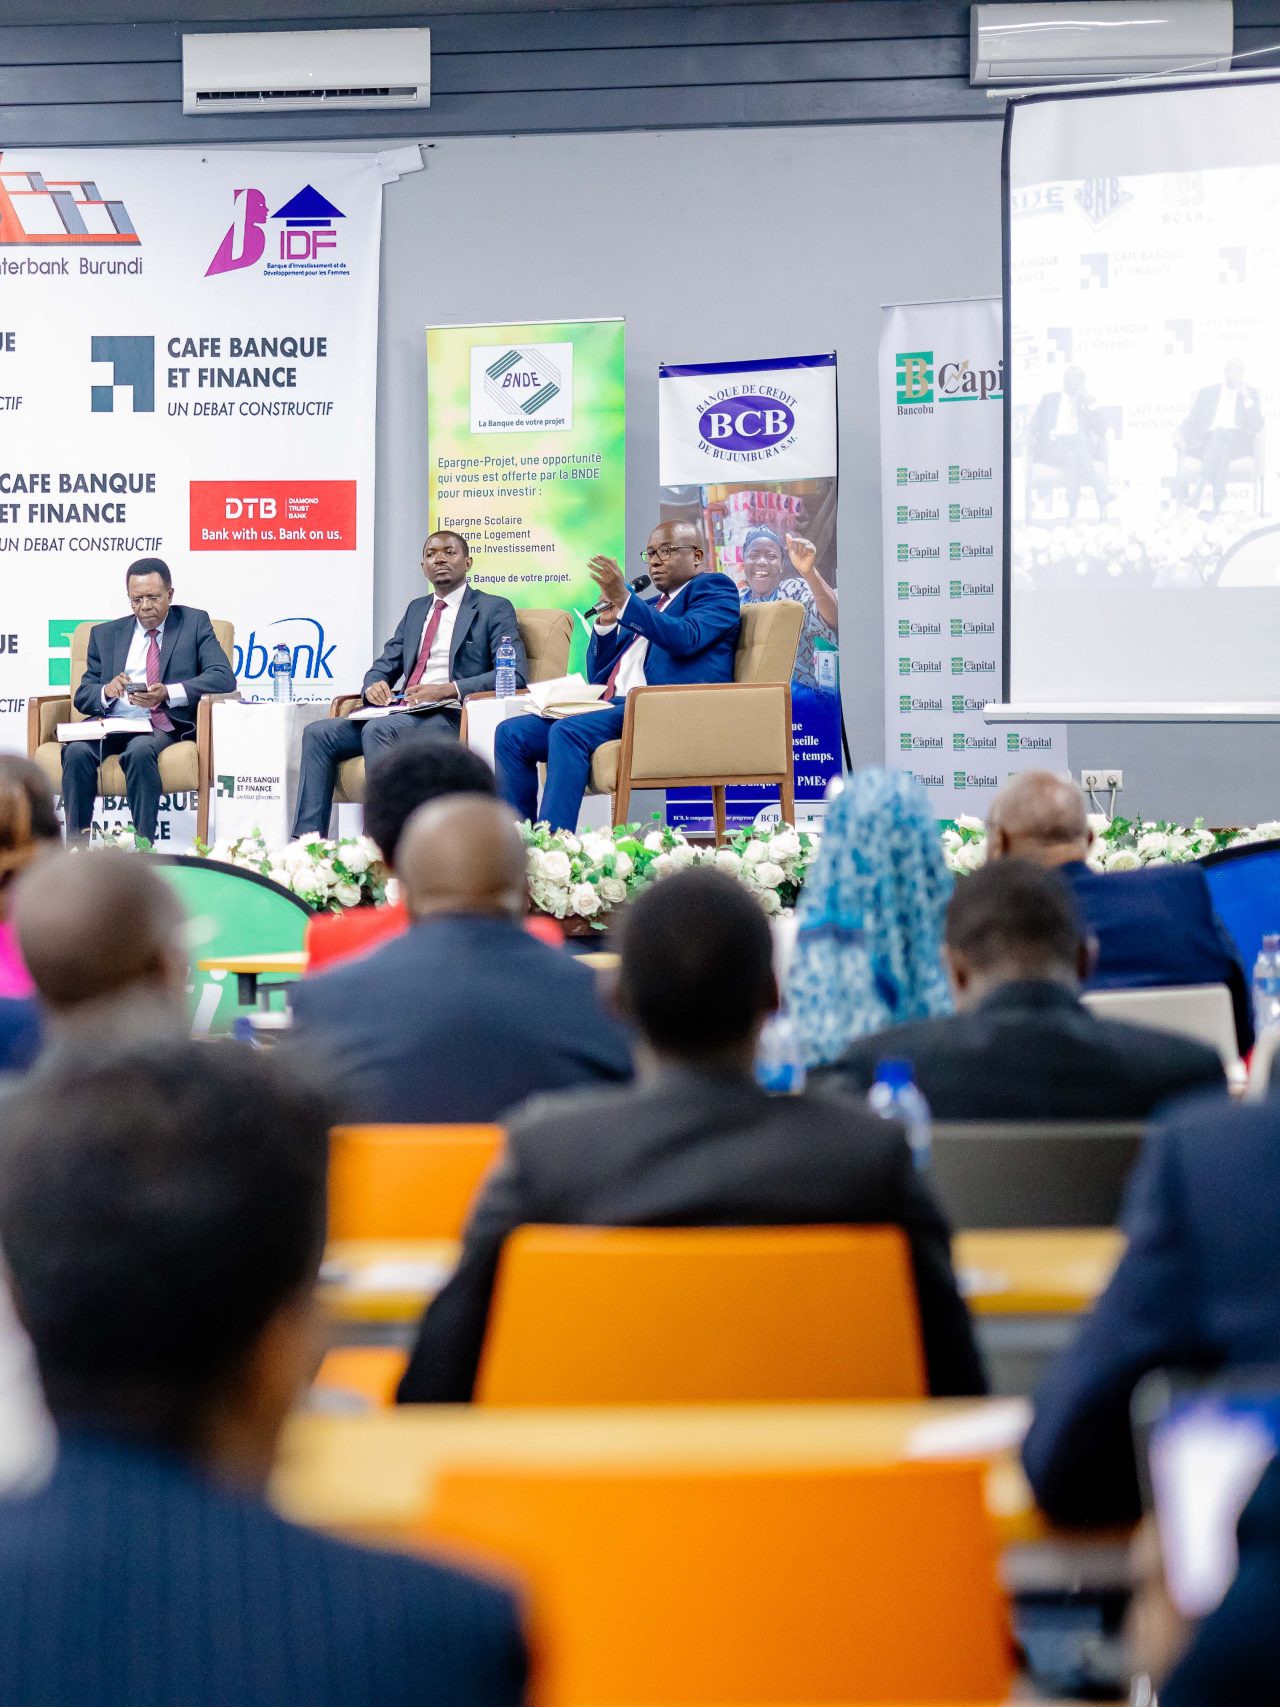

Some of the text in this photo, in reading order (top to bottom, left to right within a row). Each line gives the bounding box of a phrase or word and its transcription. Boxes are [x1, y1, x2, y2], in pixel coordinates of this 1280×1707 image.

[280, 230, 337, 260] IDF
[79, 256, 143, 275] Burundi
[167, 336, 327, 359] CAFE BANQUE
[168, 367, 297, 388] ET FINANCE
[502, 372, 541, 388] BNDE
[696, 384, 798, 414] BANQUE DE CREDIT
[167, 401, 334, 417] UN DEBAT CONSTRUCTIF
[897, 405, 934, 416] Bancobu
[707, 409, 788, 439] BCB
[697, 440, 713, 455] DE
[713, 446, 780, 463] BUJUMBURA
[438, 453, 602, 469] Epargne-Projet, une opportunité
[438, 468, 600, 485] qui vous est offerte par la BNDE
[908, 470, 939, 481] Capital
[960, 468, 993, 479] Capital
[59, 472, 156, 495] BANQUE
[438, 487, 536, 500] pour mieux investir
[28, 502, 126, 524] FINANCE
[225, 498, 277, 519] DTB
[444, 516, 522, 528] Epargne Scolaire
[201, 528, 343, 541] Bank with us. Bank on us.
[484, 530, 531, 541] Logement
[484, 544, 555, 554] Investissement
[962, 545, 994, 556] Capital
[474, 573, 571, 584] Banque de votre projet.
[910, 623, 941, 633] Capital
[964, 660, 996, 671] Capital
[912, 737, 944, 747] Capital
[1020, 737, 1052, 748] Capital
[802, 751, 834, 764] temps.
[797, 776, 827, 787] PMEs
[966, 775, 998, 786] Capital
[760, 814, 779, 823] BCB
